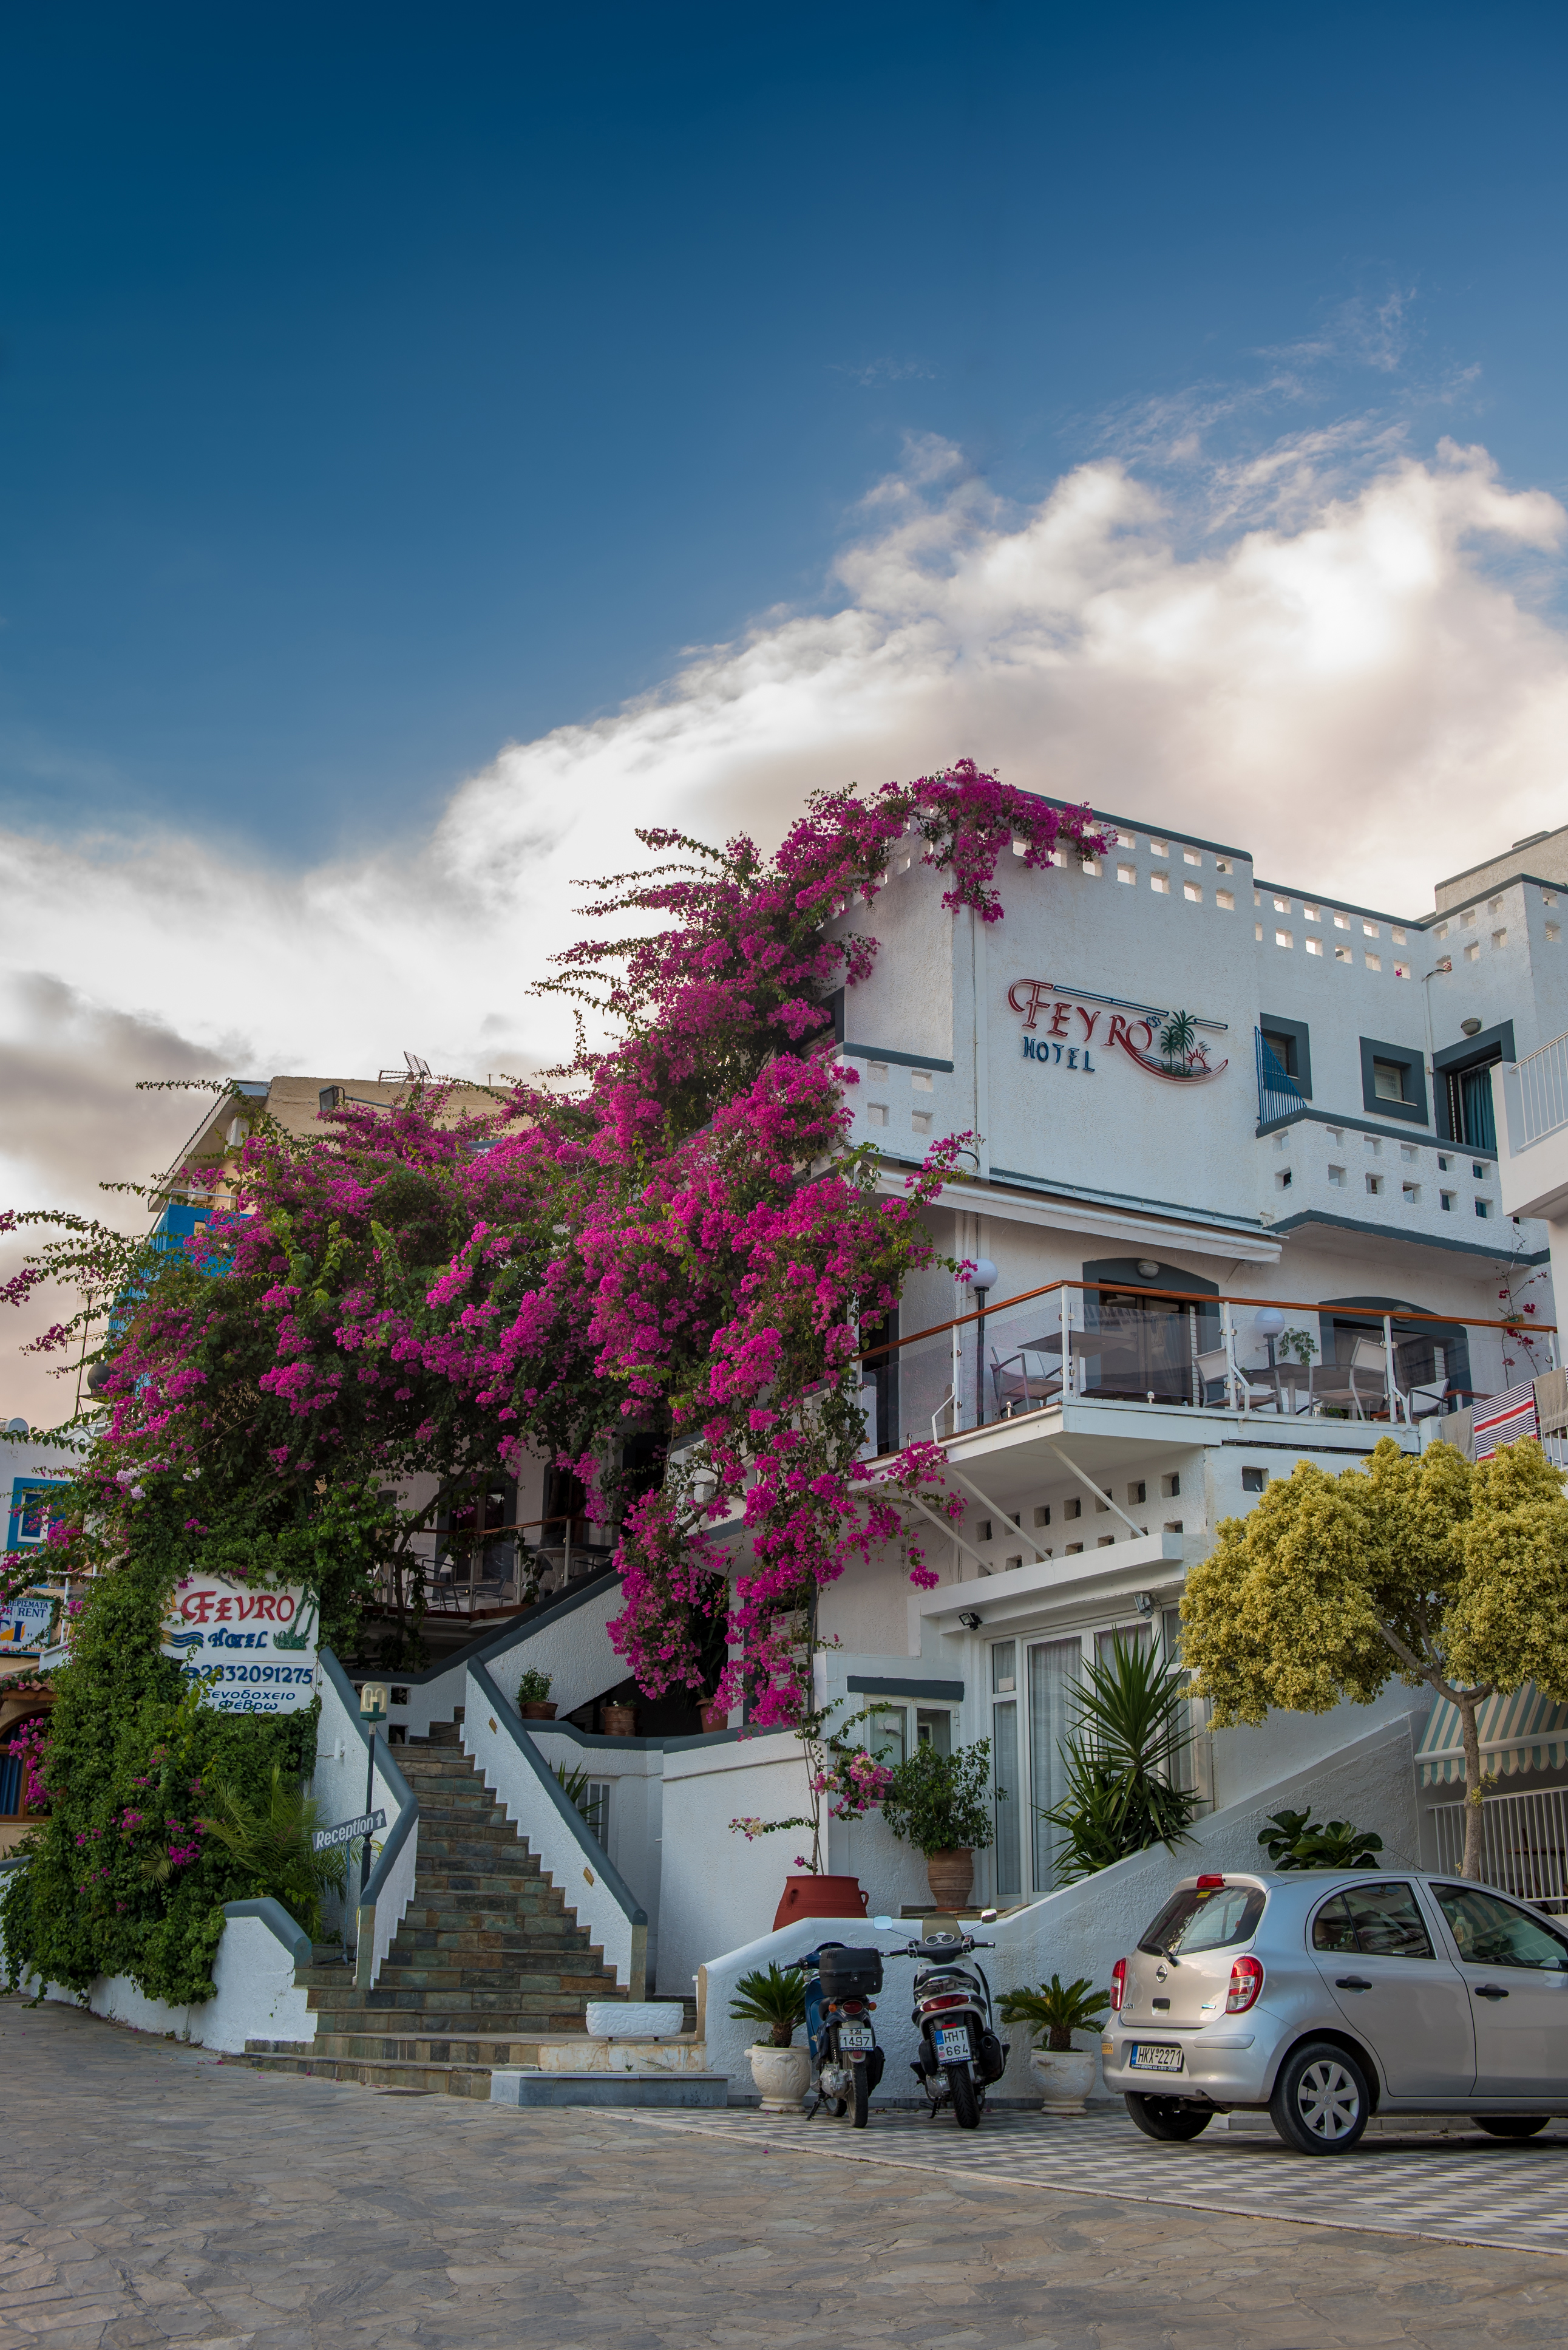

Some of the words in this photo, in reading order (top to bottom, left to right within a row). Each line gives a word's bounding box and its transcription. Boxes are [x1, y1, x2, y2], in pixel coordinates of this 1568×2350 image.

[1023, 1036, 1095, 1072] HOTEL
[18, 1607, 46, 1618] RENT
[182, 1591, 295, 1625] FEVRO
[208, 1627, 268, 1649] HOTEL
[201, 1664, 314, 1684] 2832091275
[316, 1816, 373, 1849] Reception
[843, 2036, 870, 2046] 1497
[943, 2029, 965, 2043] HHT
[946, 2043, 968, 2056] 664
